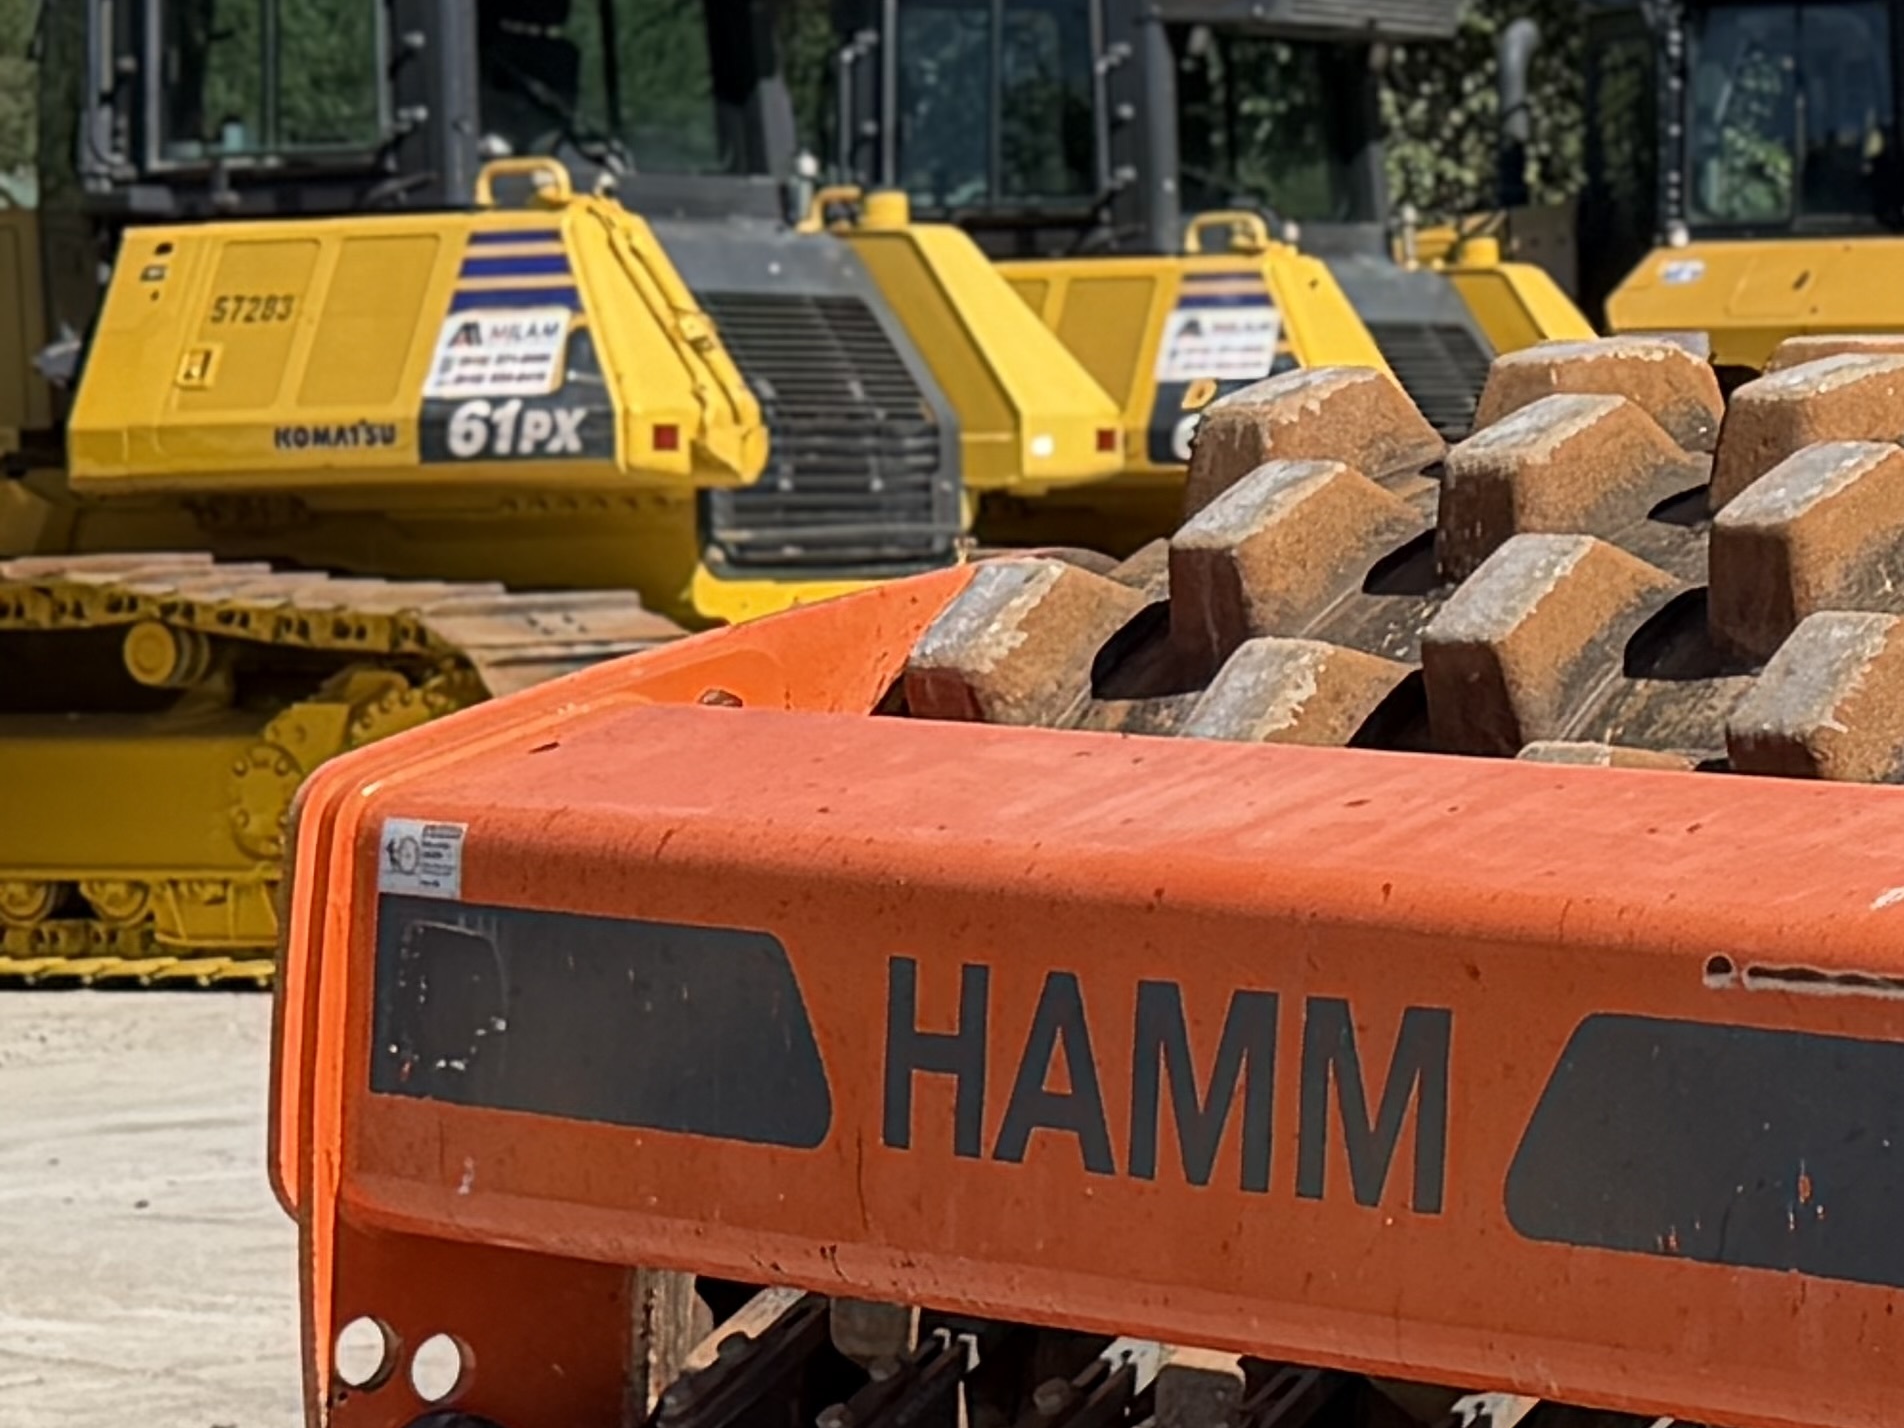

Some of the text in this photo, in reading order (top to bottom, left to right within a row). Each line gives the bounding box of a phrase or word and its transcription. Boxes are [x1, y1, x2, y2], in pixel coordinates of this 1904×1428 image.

[273, 418, 396, 449] KOMATSU
[448, 399, 587, 458] 61PX
[881, 956, 1452, 1215] HAMM
